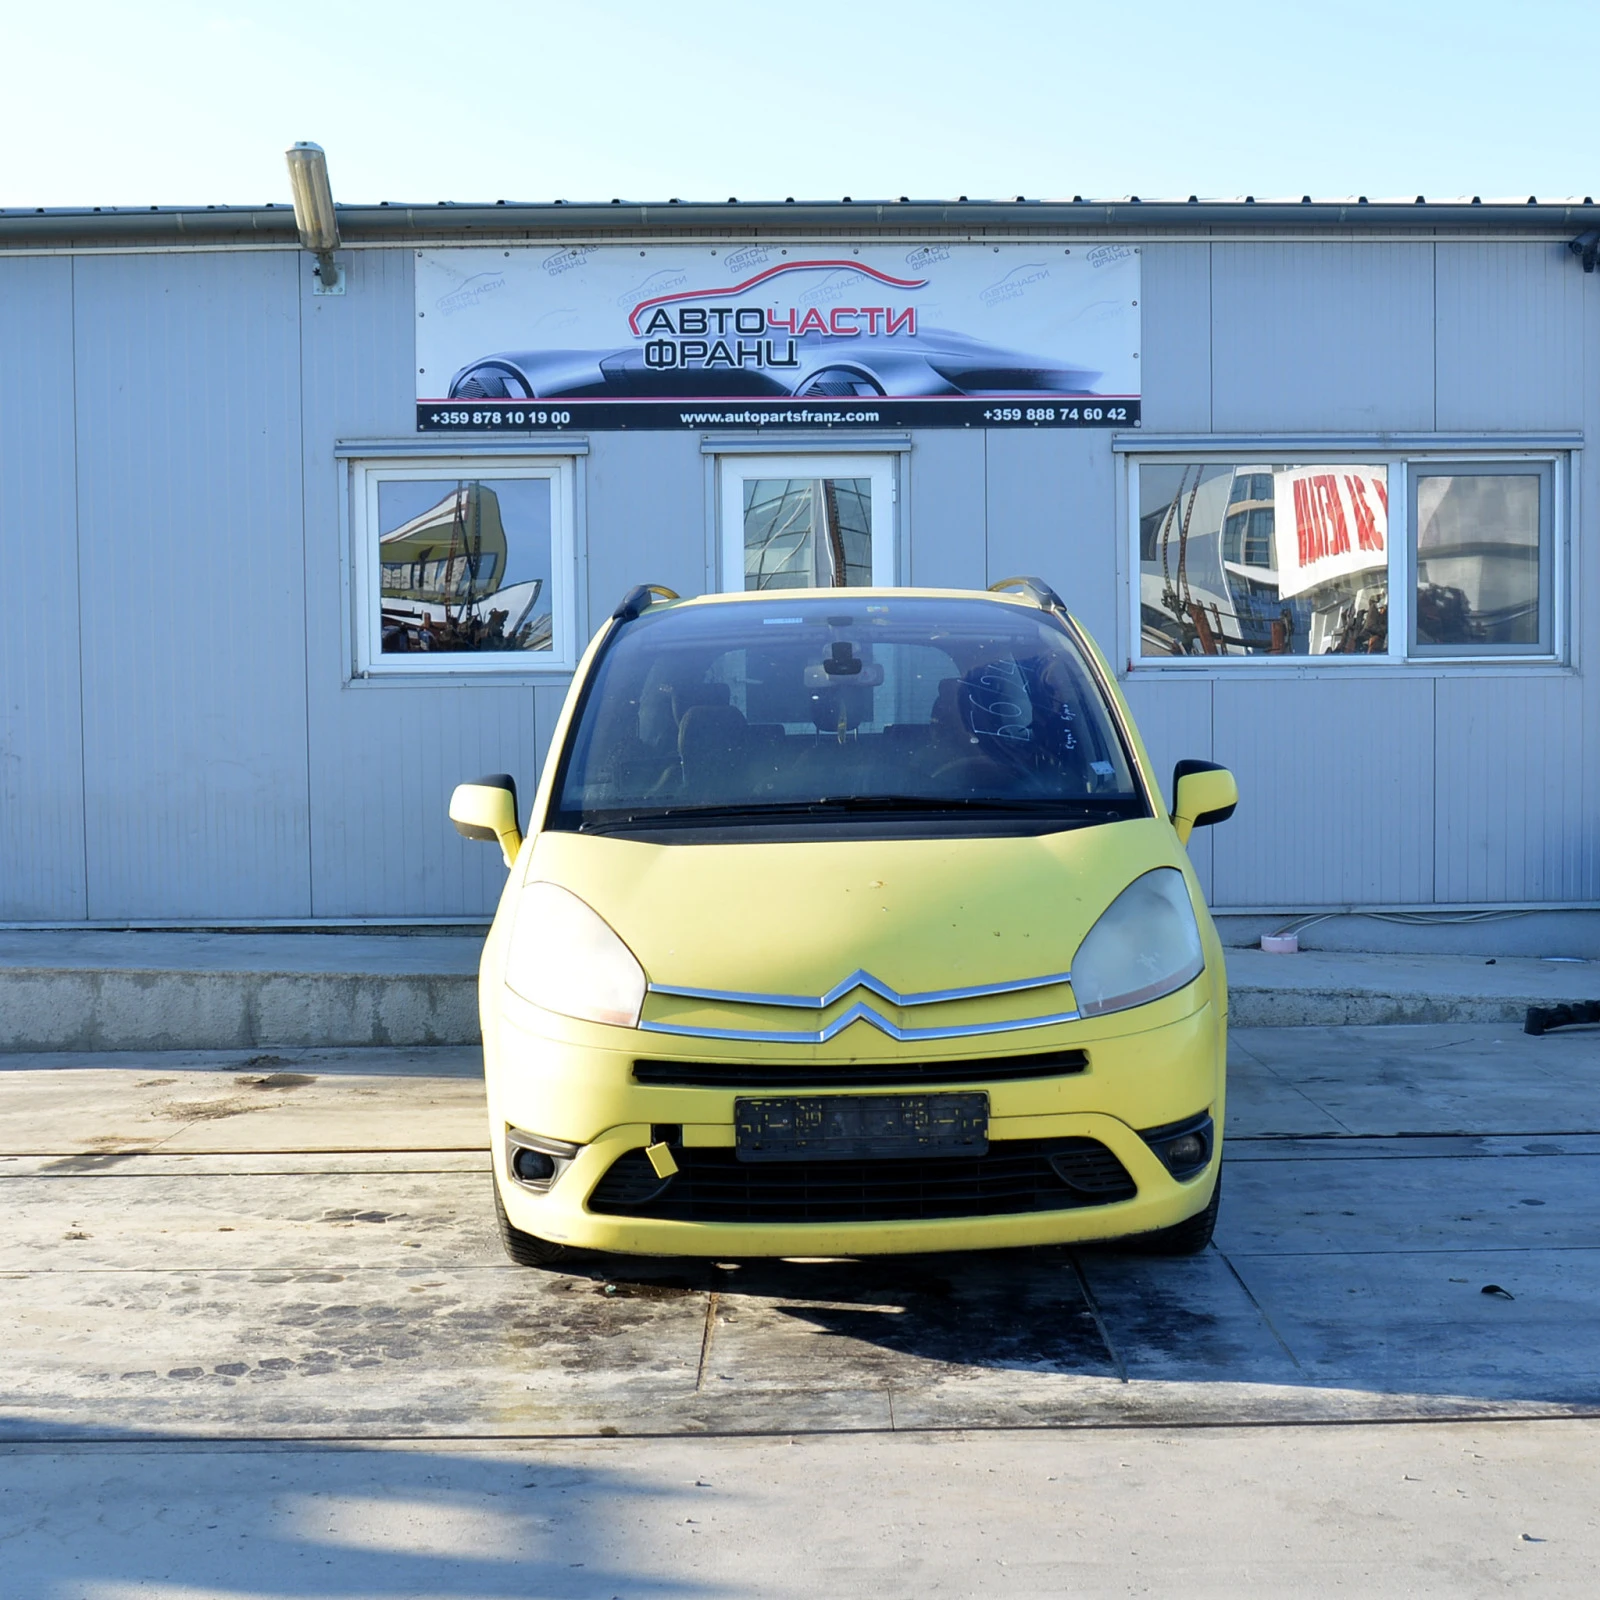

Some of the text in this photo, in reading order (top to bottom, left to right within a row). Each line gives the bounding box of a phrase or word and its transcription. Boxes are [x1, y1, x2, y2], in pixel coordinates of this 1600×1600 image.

[645, 308, 914, 334] АВТОЧАСТИ
[644, 338, 798, 367] ФРАНЦ
[431, 411, 570, 424] +359 878 10 19 00
[680, 410, 879, 425] www.autopartsfranz.com
[983, 408, 1126, 420] +359 888 74 60 42
